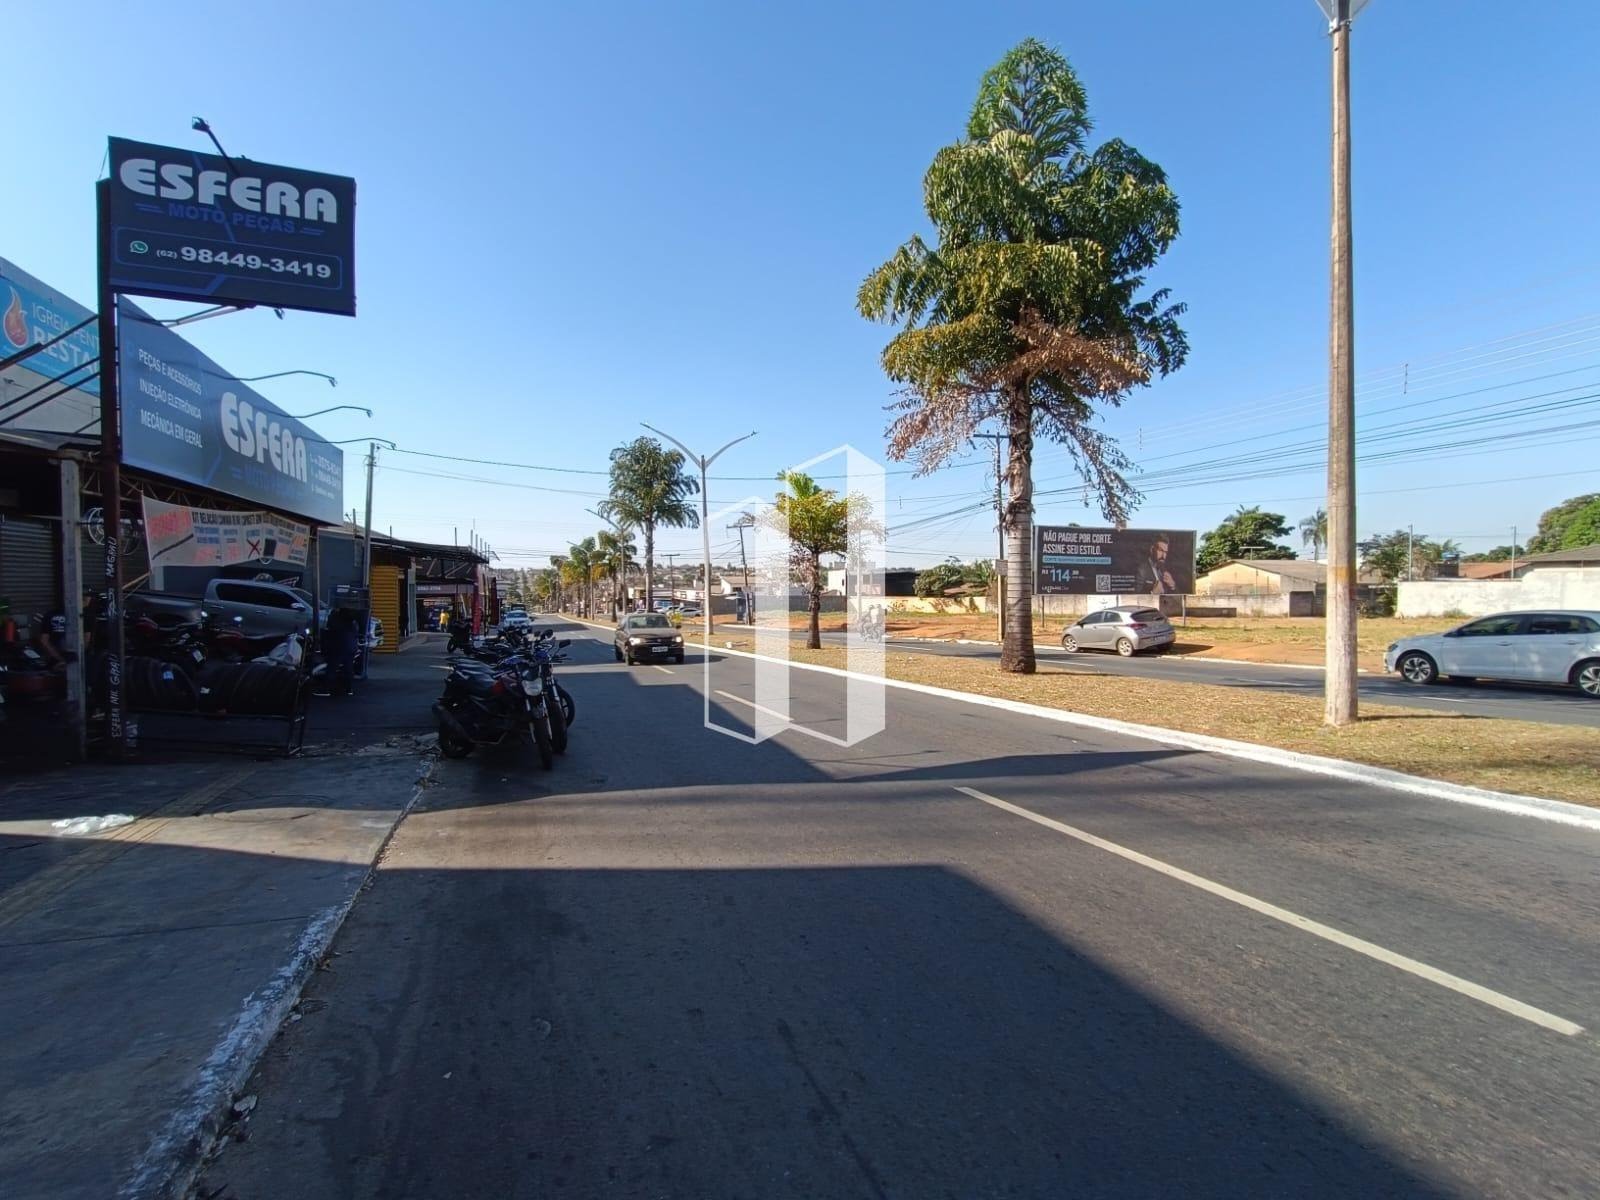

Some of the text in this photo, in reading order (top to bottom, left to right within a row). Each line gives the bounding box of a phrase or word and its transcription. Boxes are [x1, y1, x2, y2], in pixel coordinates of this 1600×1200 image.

[120, 158, 338, 224] ESFERA
[168, 203, 296, 235] MOTO PEÇAS
[180, 246, 331, 279] 98449-3419
[138, 348, 161, 373] PEÇAS
[161, 362, 167, 376] E
[139, 378, 167, 403] INJEÇÃO
[140, 408, 203, 449] MECÂNICA EM GERAL
[220, 391, 308, 483] ESFERA
[1042, 543, 1102, 555] ASSINE SEU ESTILO.
[1043, 530, 1114, 544] NÃO PAGUE POR CORTE.
[1050, 568, 1071, 582] 114
